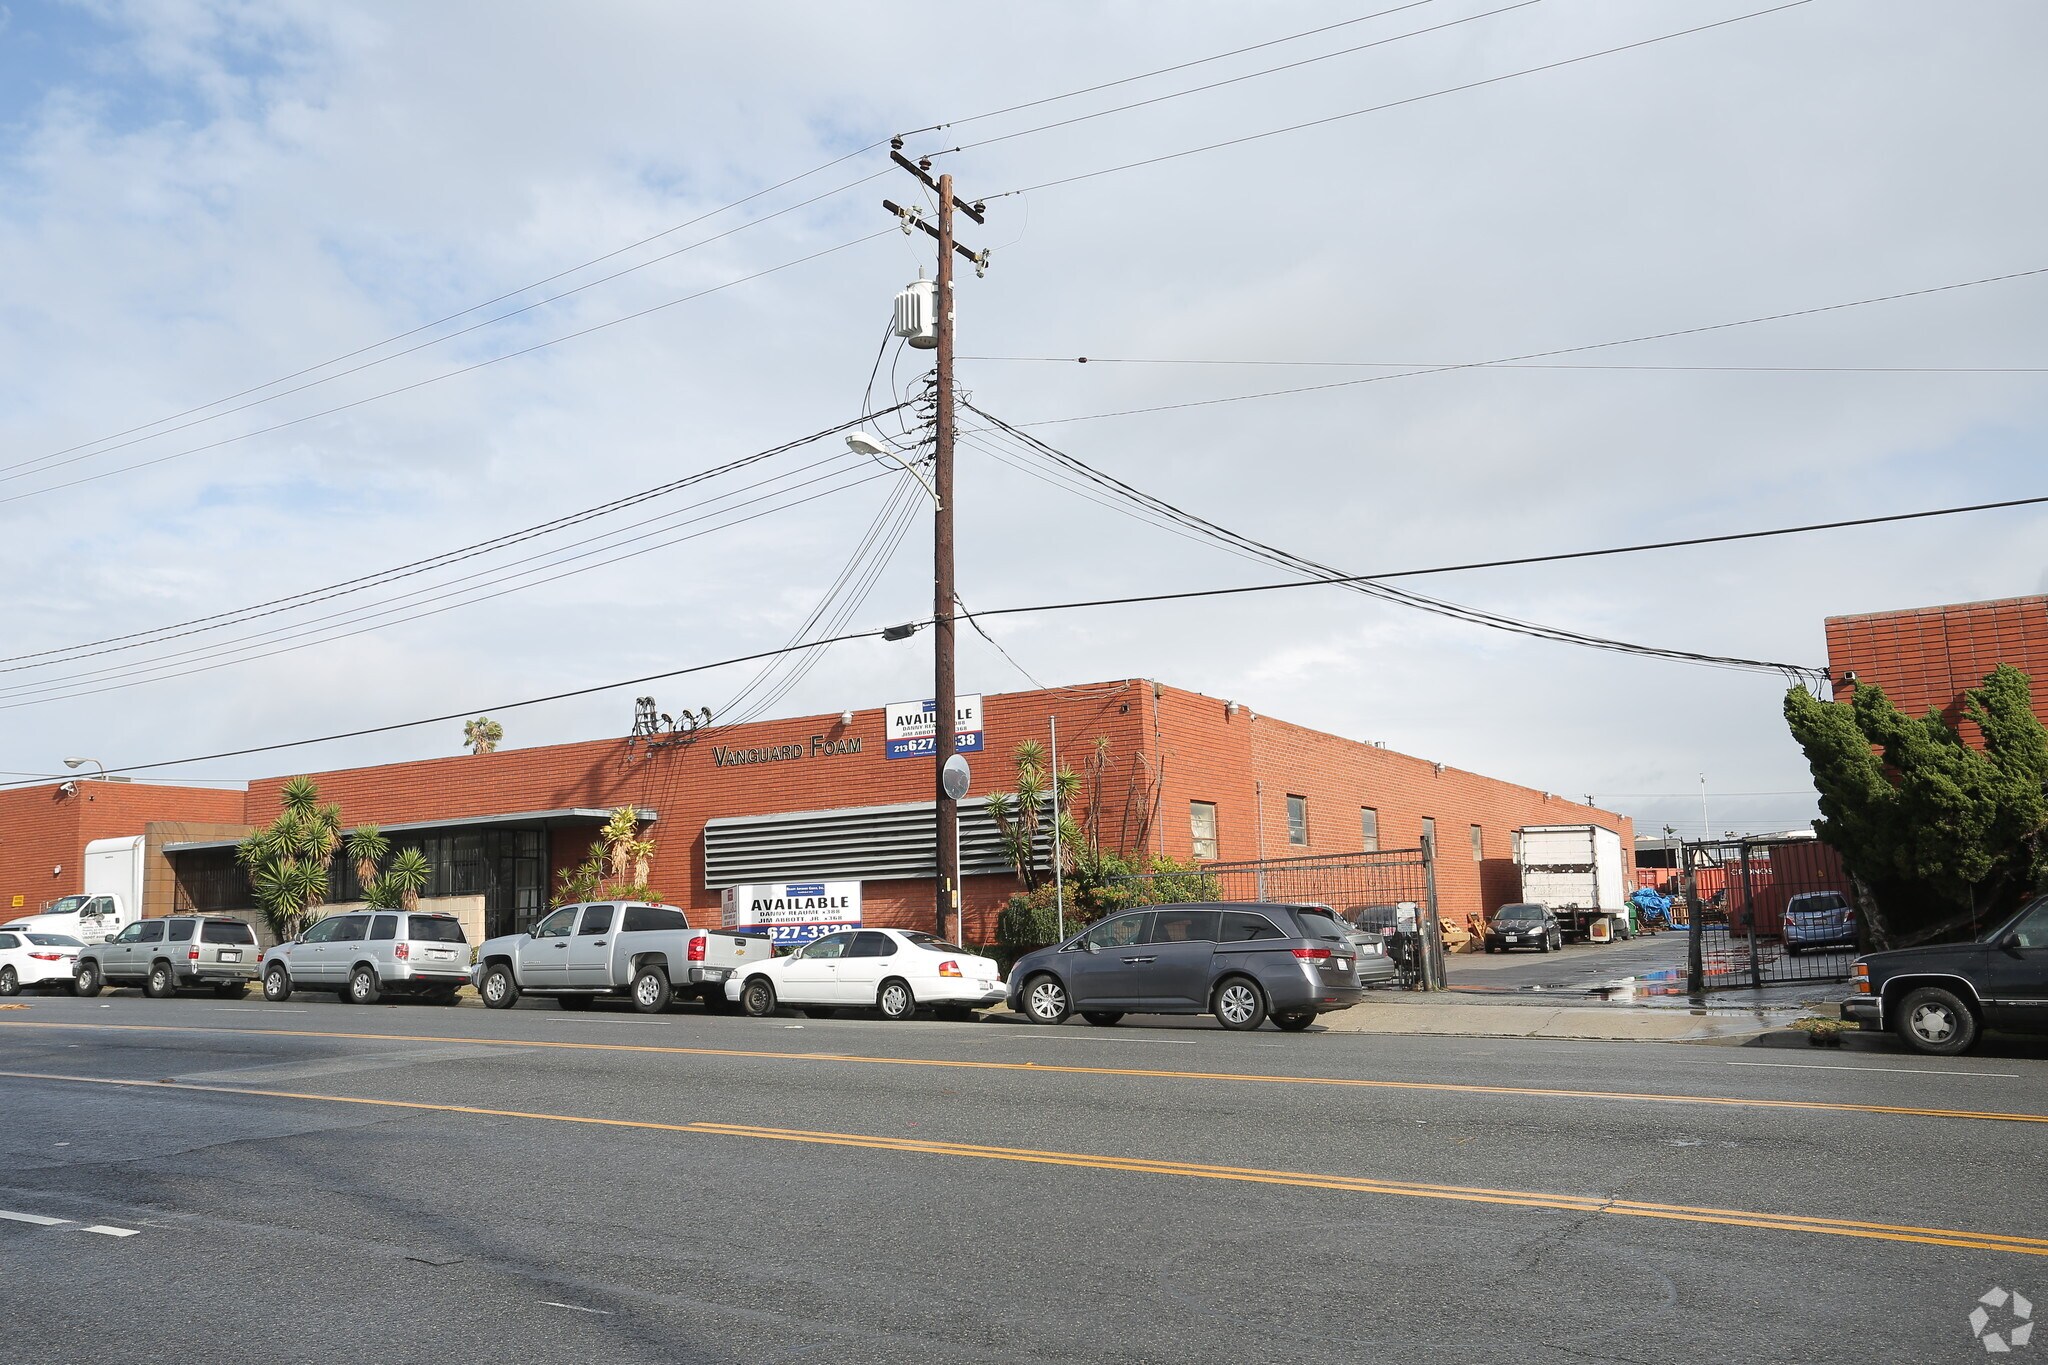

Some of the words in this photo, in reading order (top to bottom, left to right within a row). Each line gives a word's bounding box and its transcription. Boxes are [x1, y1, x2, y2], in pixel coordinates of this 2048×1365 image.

[896, 708, 973, 727] AVAILLE
[712, 744, 804, 768] VANGUARD
[810, 734, 863, 757] FOAM
[894, 744, 908, 753] 213
[908, 733, 976, 751] 62738
[751, 896, 849, 911] AVAILABLE
